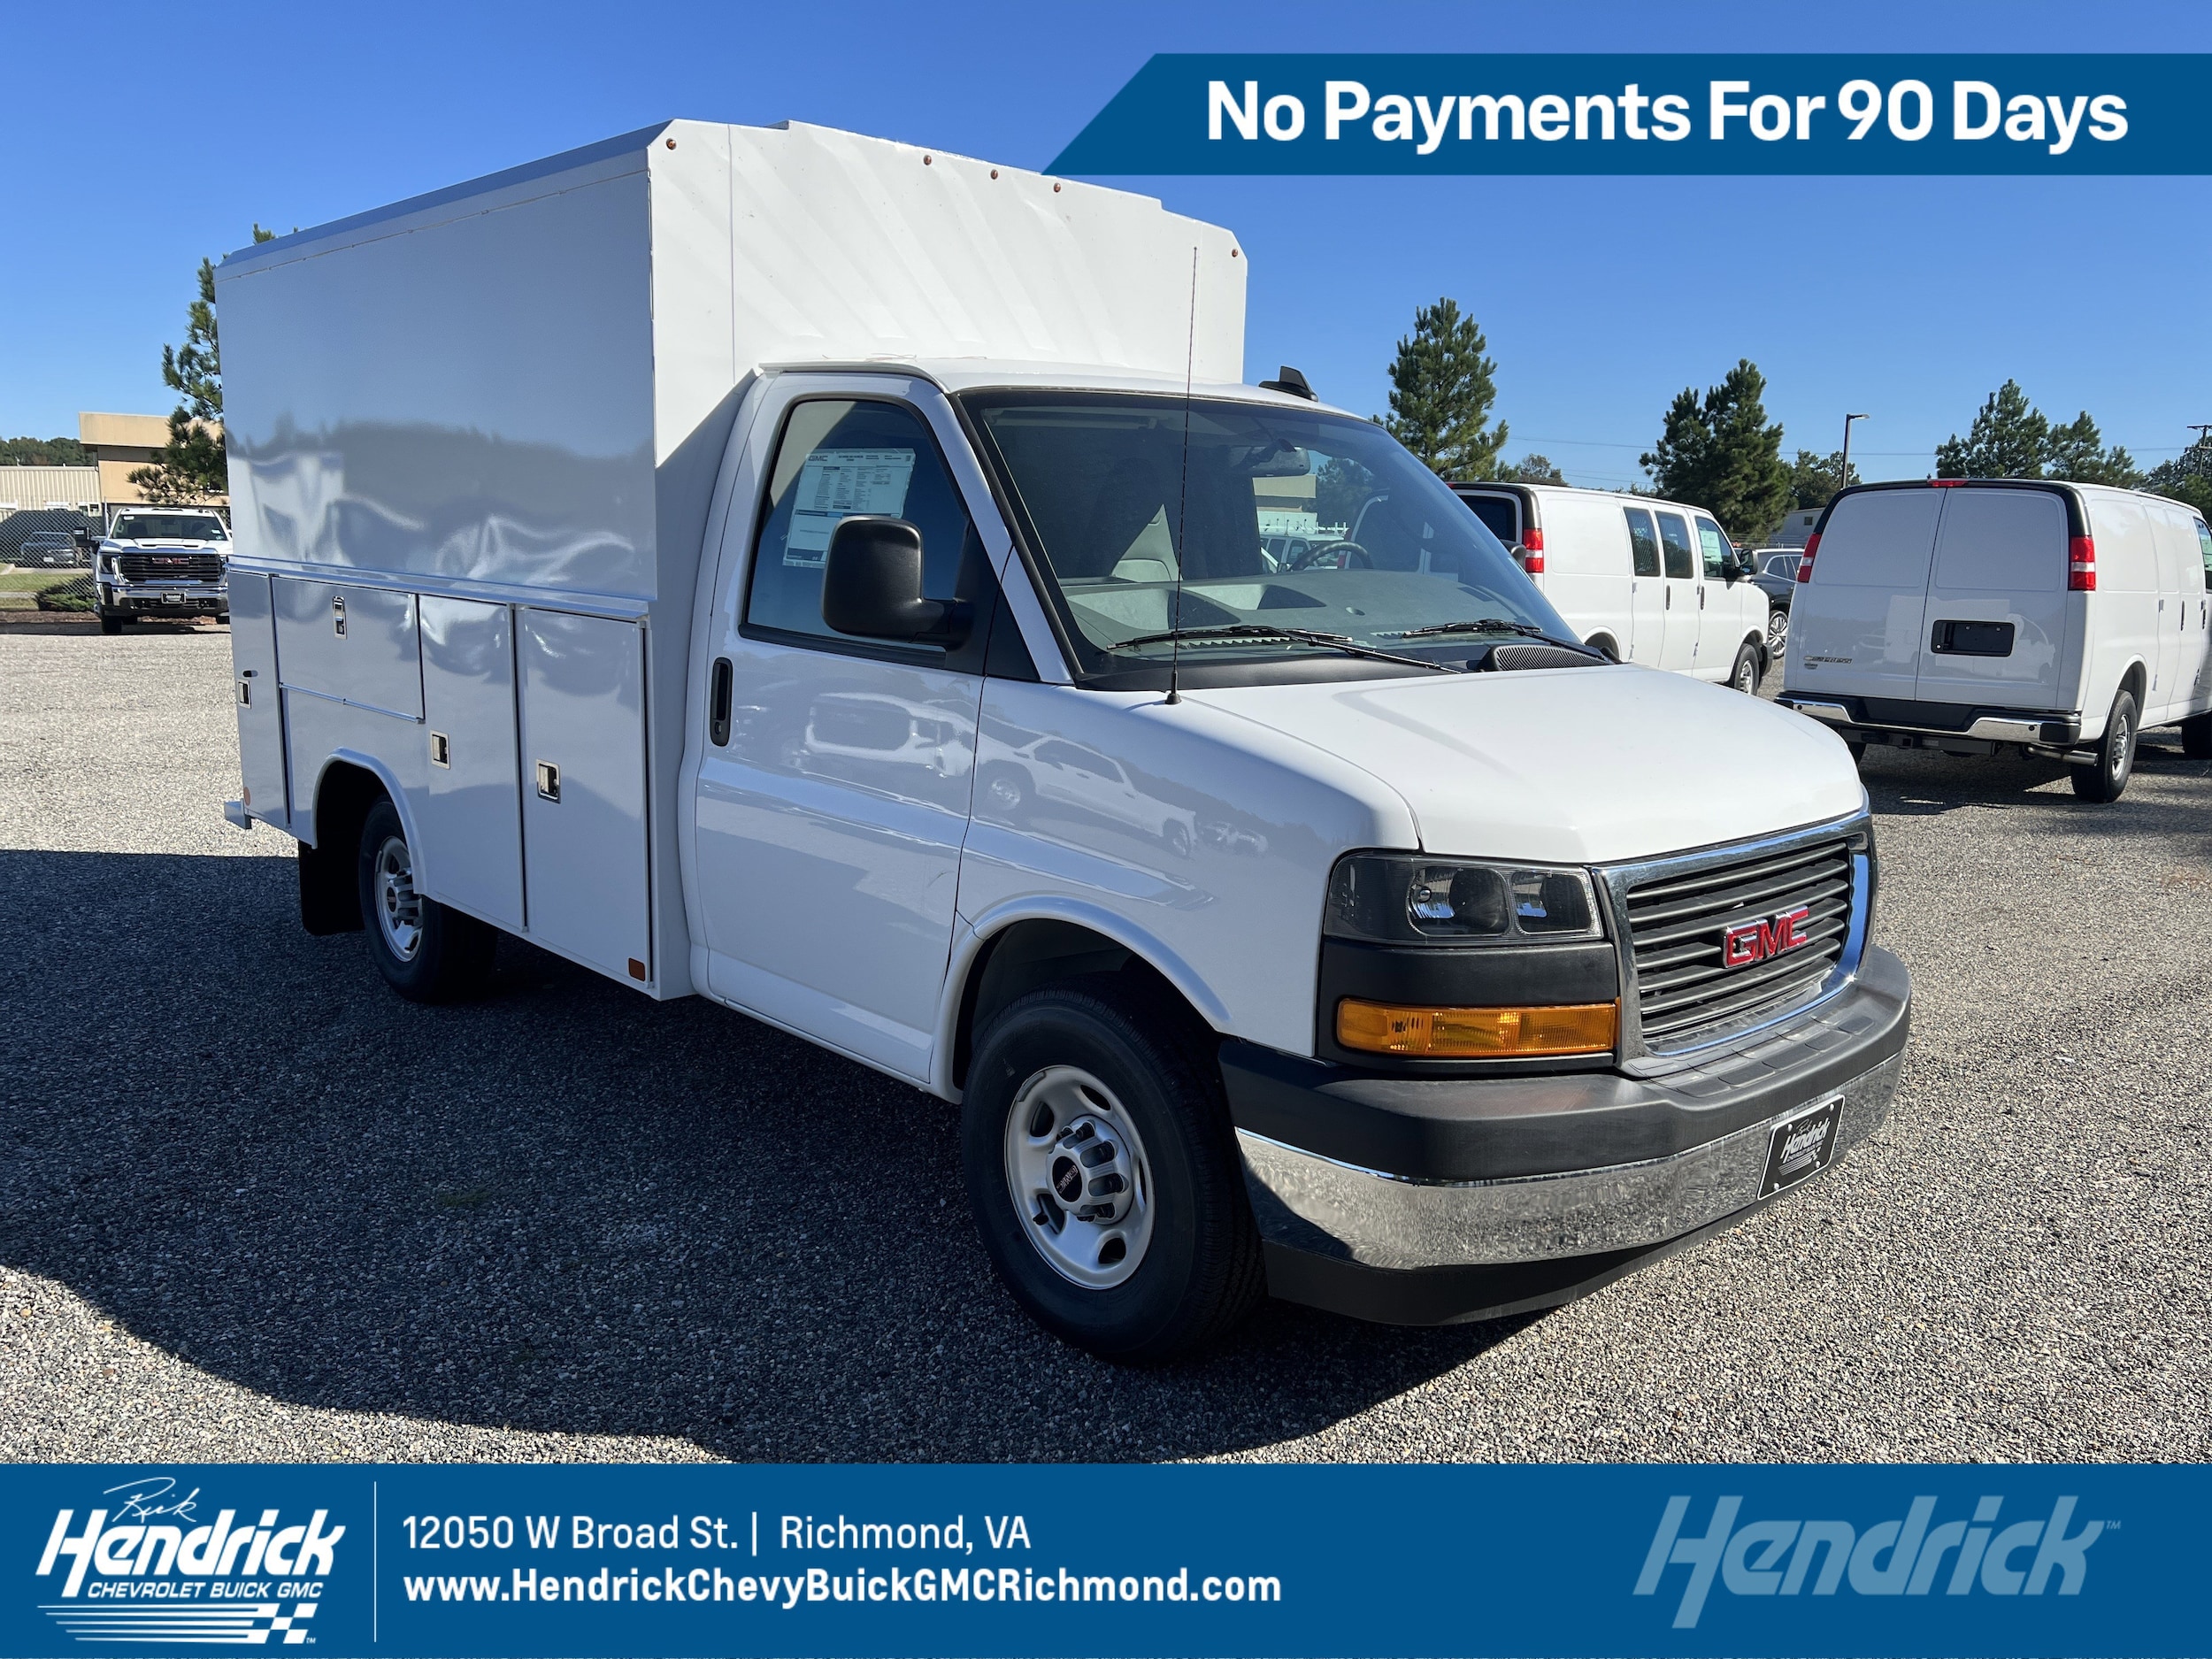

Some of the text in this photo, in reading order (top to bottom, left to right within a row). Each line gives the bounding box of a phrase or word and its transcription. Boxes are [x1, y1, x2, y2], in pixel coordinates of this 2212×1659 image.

[152, 557, 189, 565] GMC
[1724, 904, 1810, 968] GMC
[1780, 1118, 1831, 1164] Hendrick
[1056, 1164, 1079, 1194] GMC
